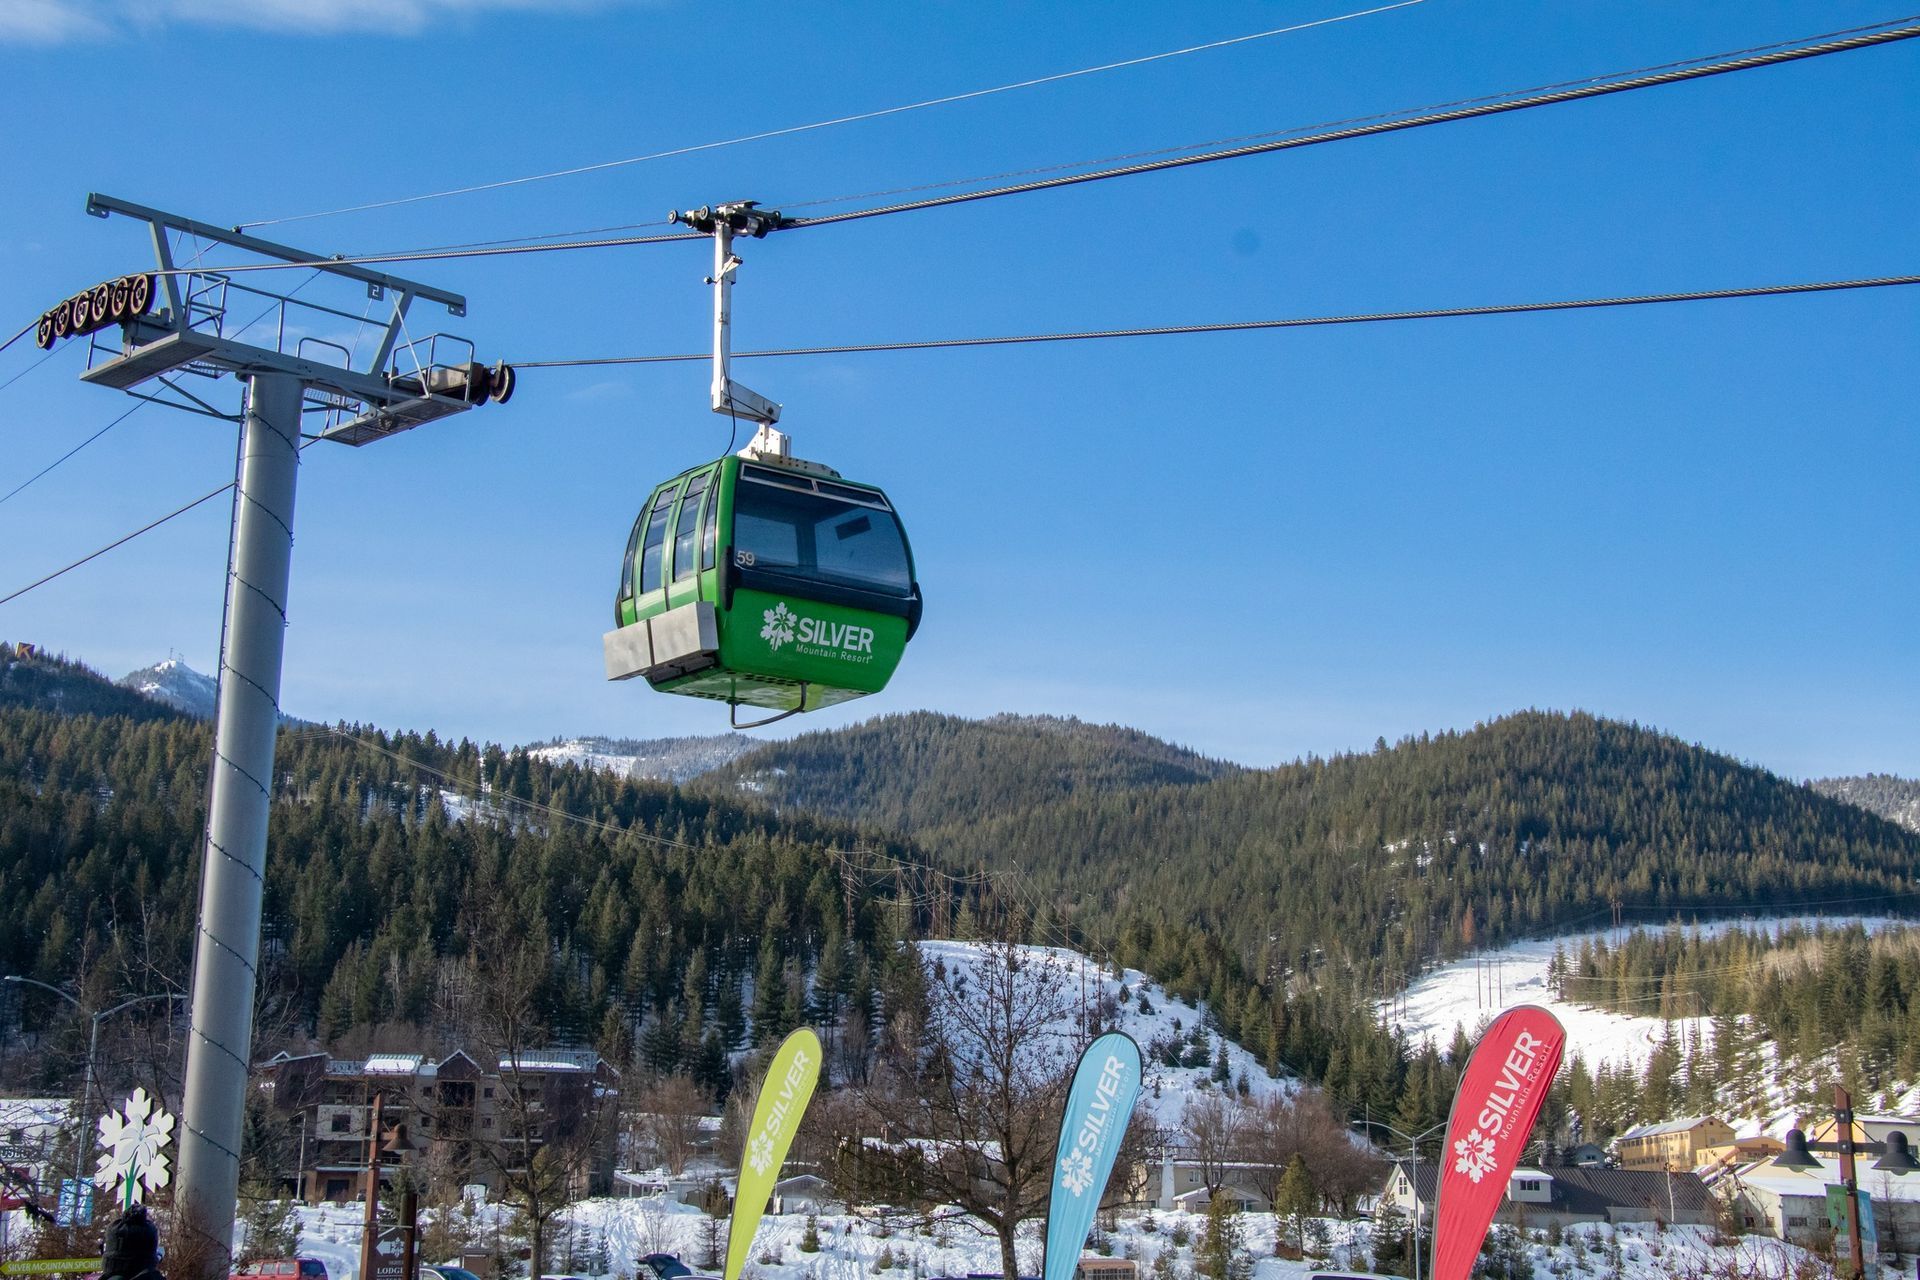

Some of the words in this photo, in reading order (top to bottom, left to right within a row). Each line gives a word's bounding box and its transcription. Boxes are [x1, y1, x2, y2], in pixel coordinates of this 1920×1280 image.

[736, 550, 755, 566] 59
[795, 643, 837, 659] Mountain
[840, 650, 869, 664] Resort
[796, 617, 874, 653] SILVER
[766, 1050, 810, 1137] SILVER
[1079, 1055, 1125, 1153] SILVER
[1478, 1031, 1542, 1136] SILVER
[1500, 1087, 1531, 1141] Mountain
[1526, 1044, 1552, 1083] Resort
[8, 1263, 31, 1272] SILVER
[31, 1262, 73, 1271] MOUNTAIN
[74, 1260, 102, 1270] SPORTS
